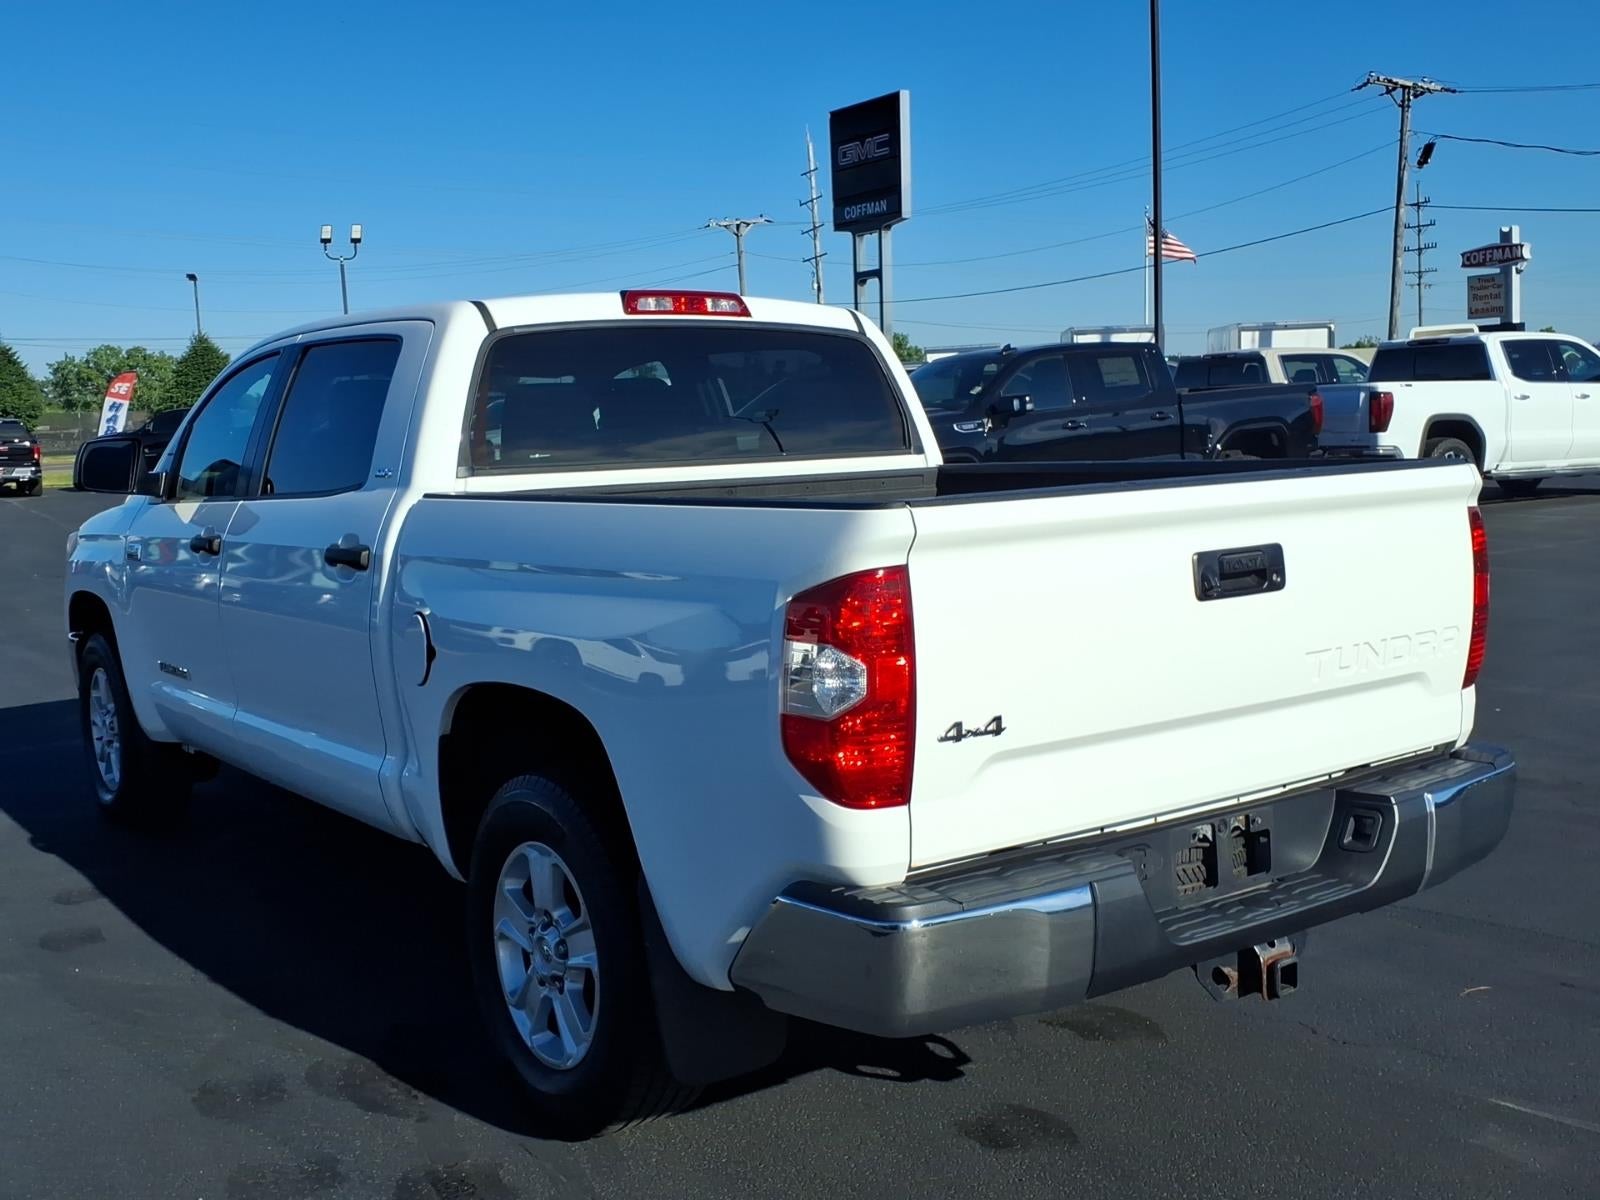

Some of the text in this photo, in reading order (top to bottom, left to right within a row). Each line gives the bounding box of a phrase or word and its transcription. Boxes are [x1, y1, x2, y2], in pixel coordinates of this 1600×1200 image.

[838, 133, 889, 166] GMC
[844, 199, 888, 220] COFFMAN
[1463, 245, 1522, 265] COFFMAN
[1472, 292, 1502, 302] Rental
[1470, 305, 1504, 315] Leasing
[1305, 625, 1460, 684] TUNDRA
